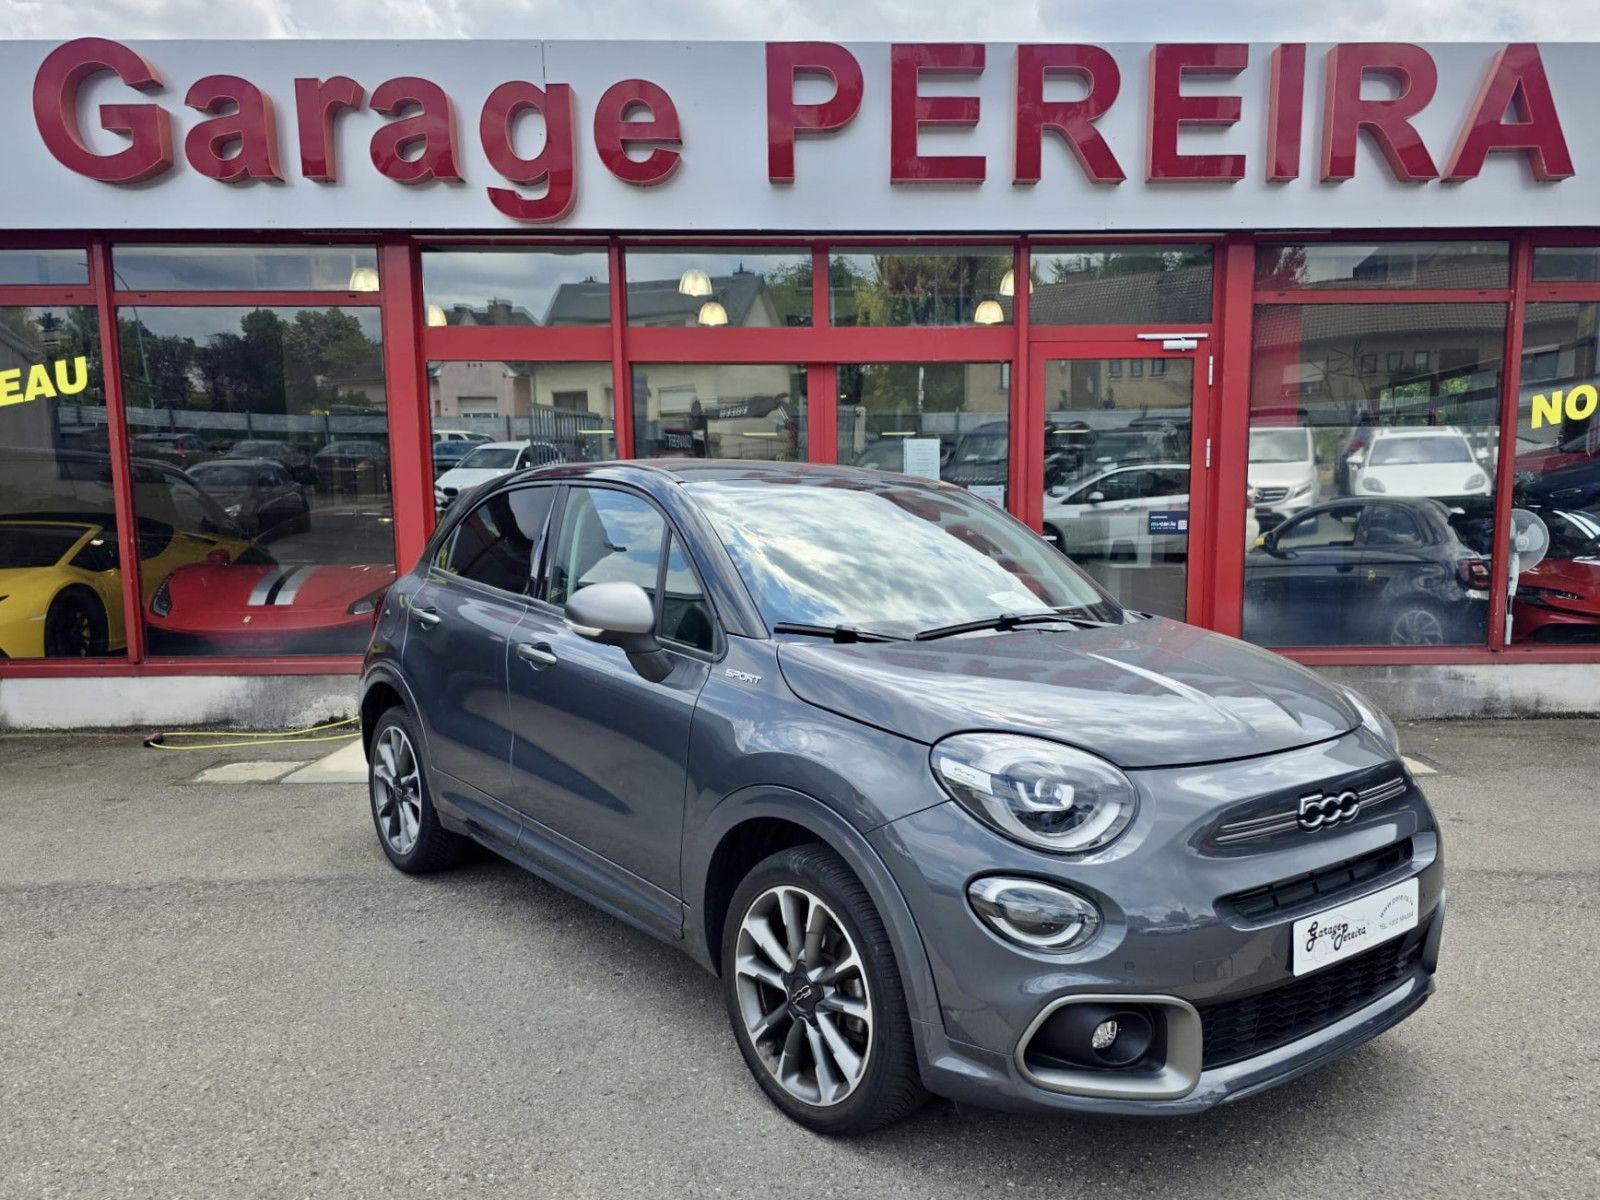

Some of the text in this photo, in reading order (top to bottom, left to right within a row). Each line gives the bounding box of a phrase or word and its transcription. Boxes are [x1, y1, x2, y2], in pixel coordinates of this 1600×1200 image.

[33, 38, 1575, 222] Garage PEREIRA
[0, 355, 89, 407] EAU
[1531, 384, 1598, 429] NO
[725, 668, 762, 684] SPORT
[1299, 791, 1359, 829] 500
[1306, 921, 1367, 953] Garage Pereira
